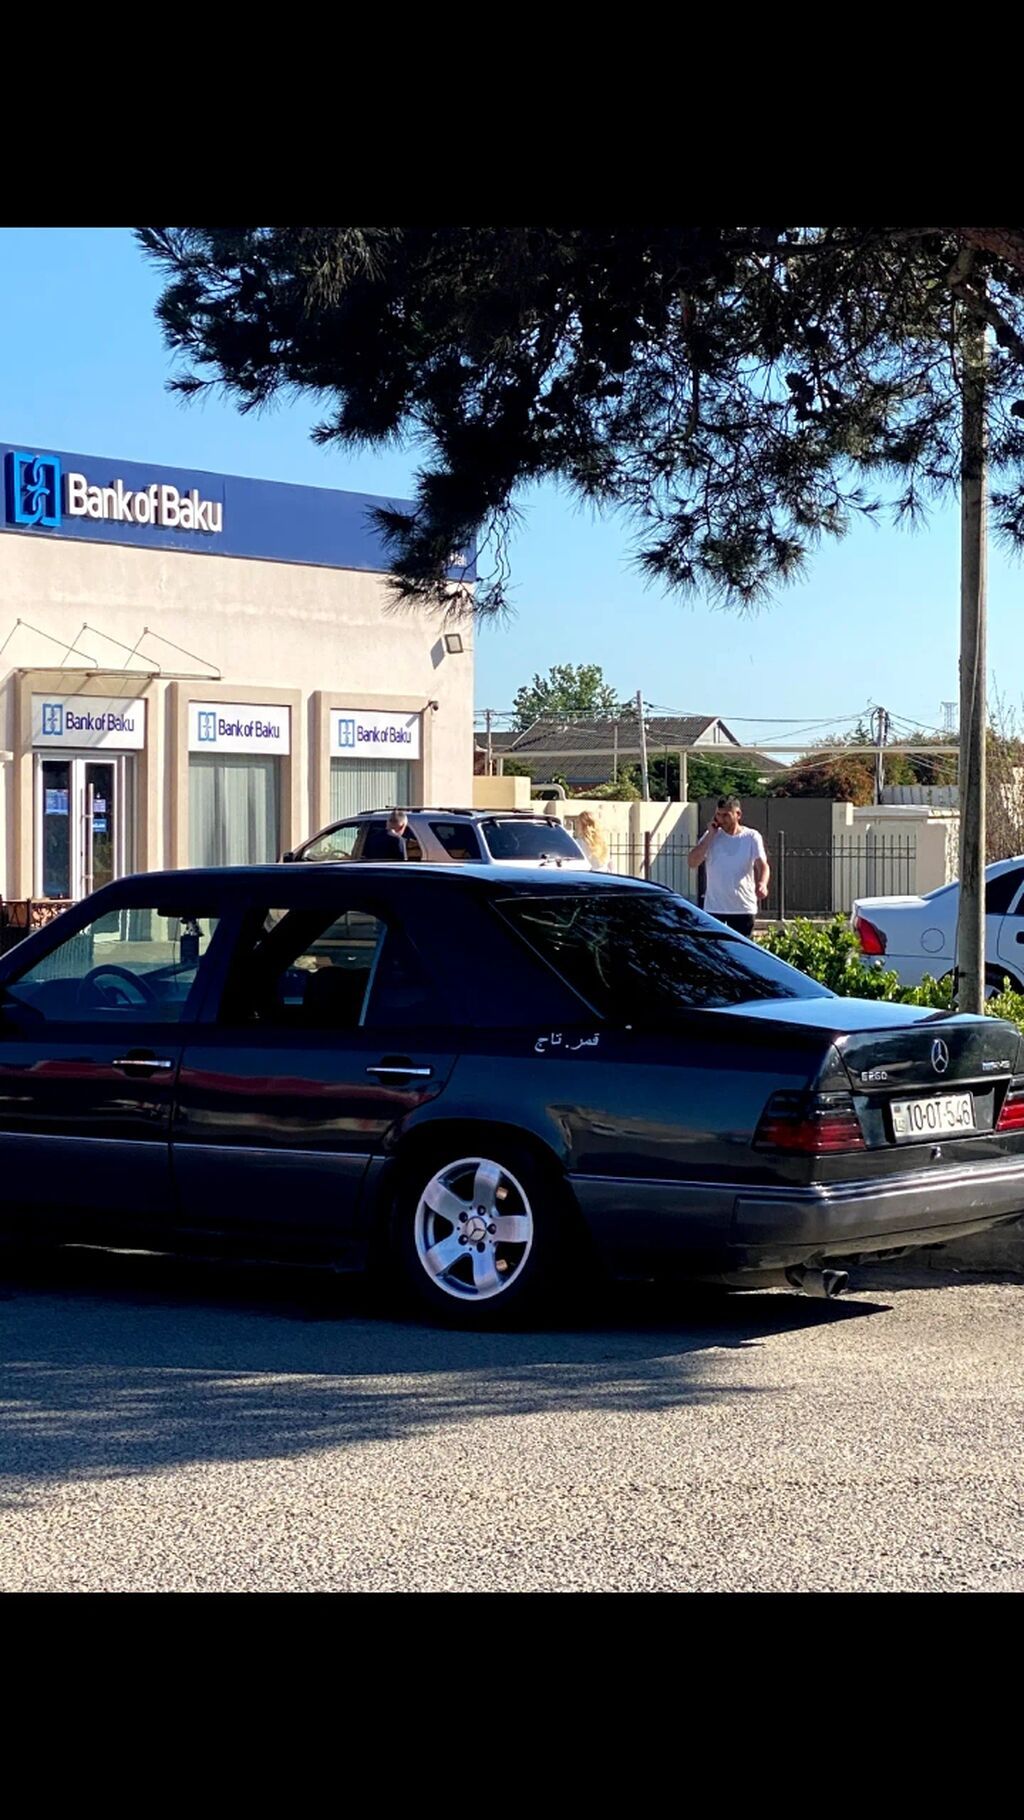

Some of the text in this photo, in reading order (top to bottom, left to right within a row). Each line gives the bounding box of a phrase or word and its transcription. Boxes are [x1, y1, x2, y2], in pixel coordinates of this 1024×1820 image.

[67, 472, 223, 532] Bank of Baku
[66, 711, 135, 732] Bank of Baku
[218, 719, 280, 738] Bank of Baku
[357, 726, 412, 743] Bank of Baku
